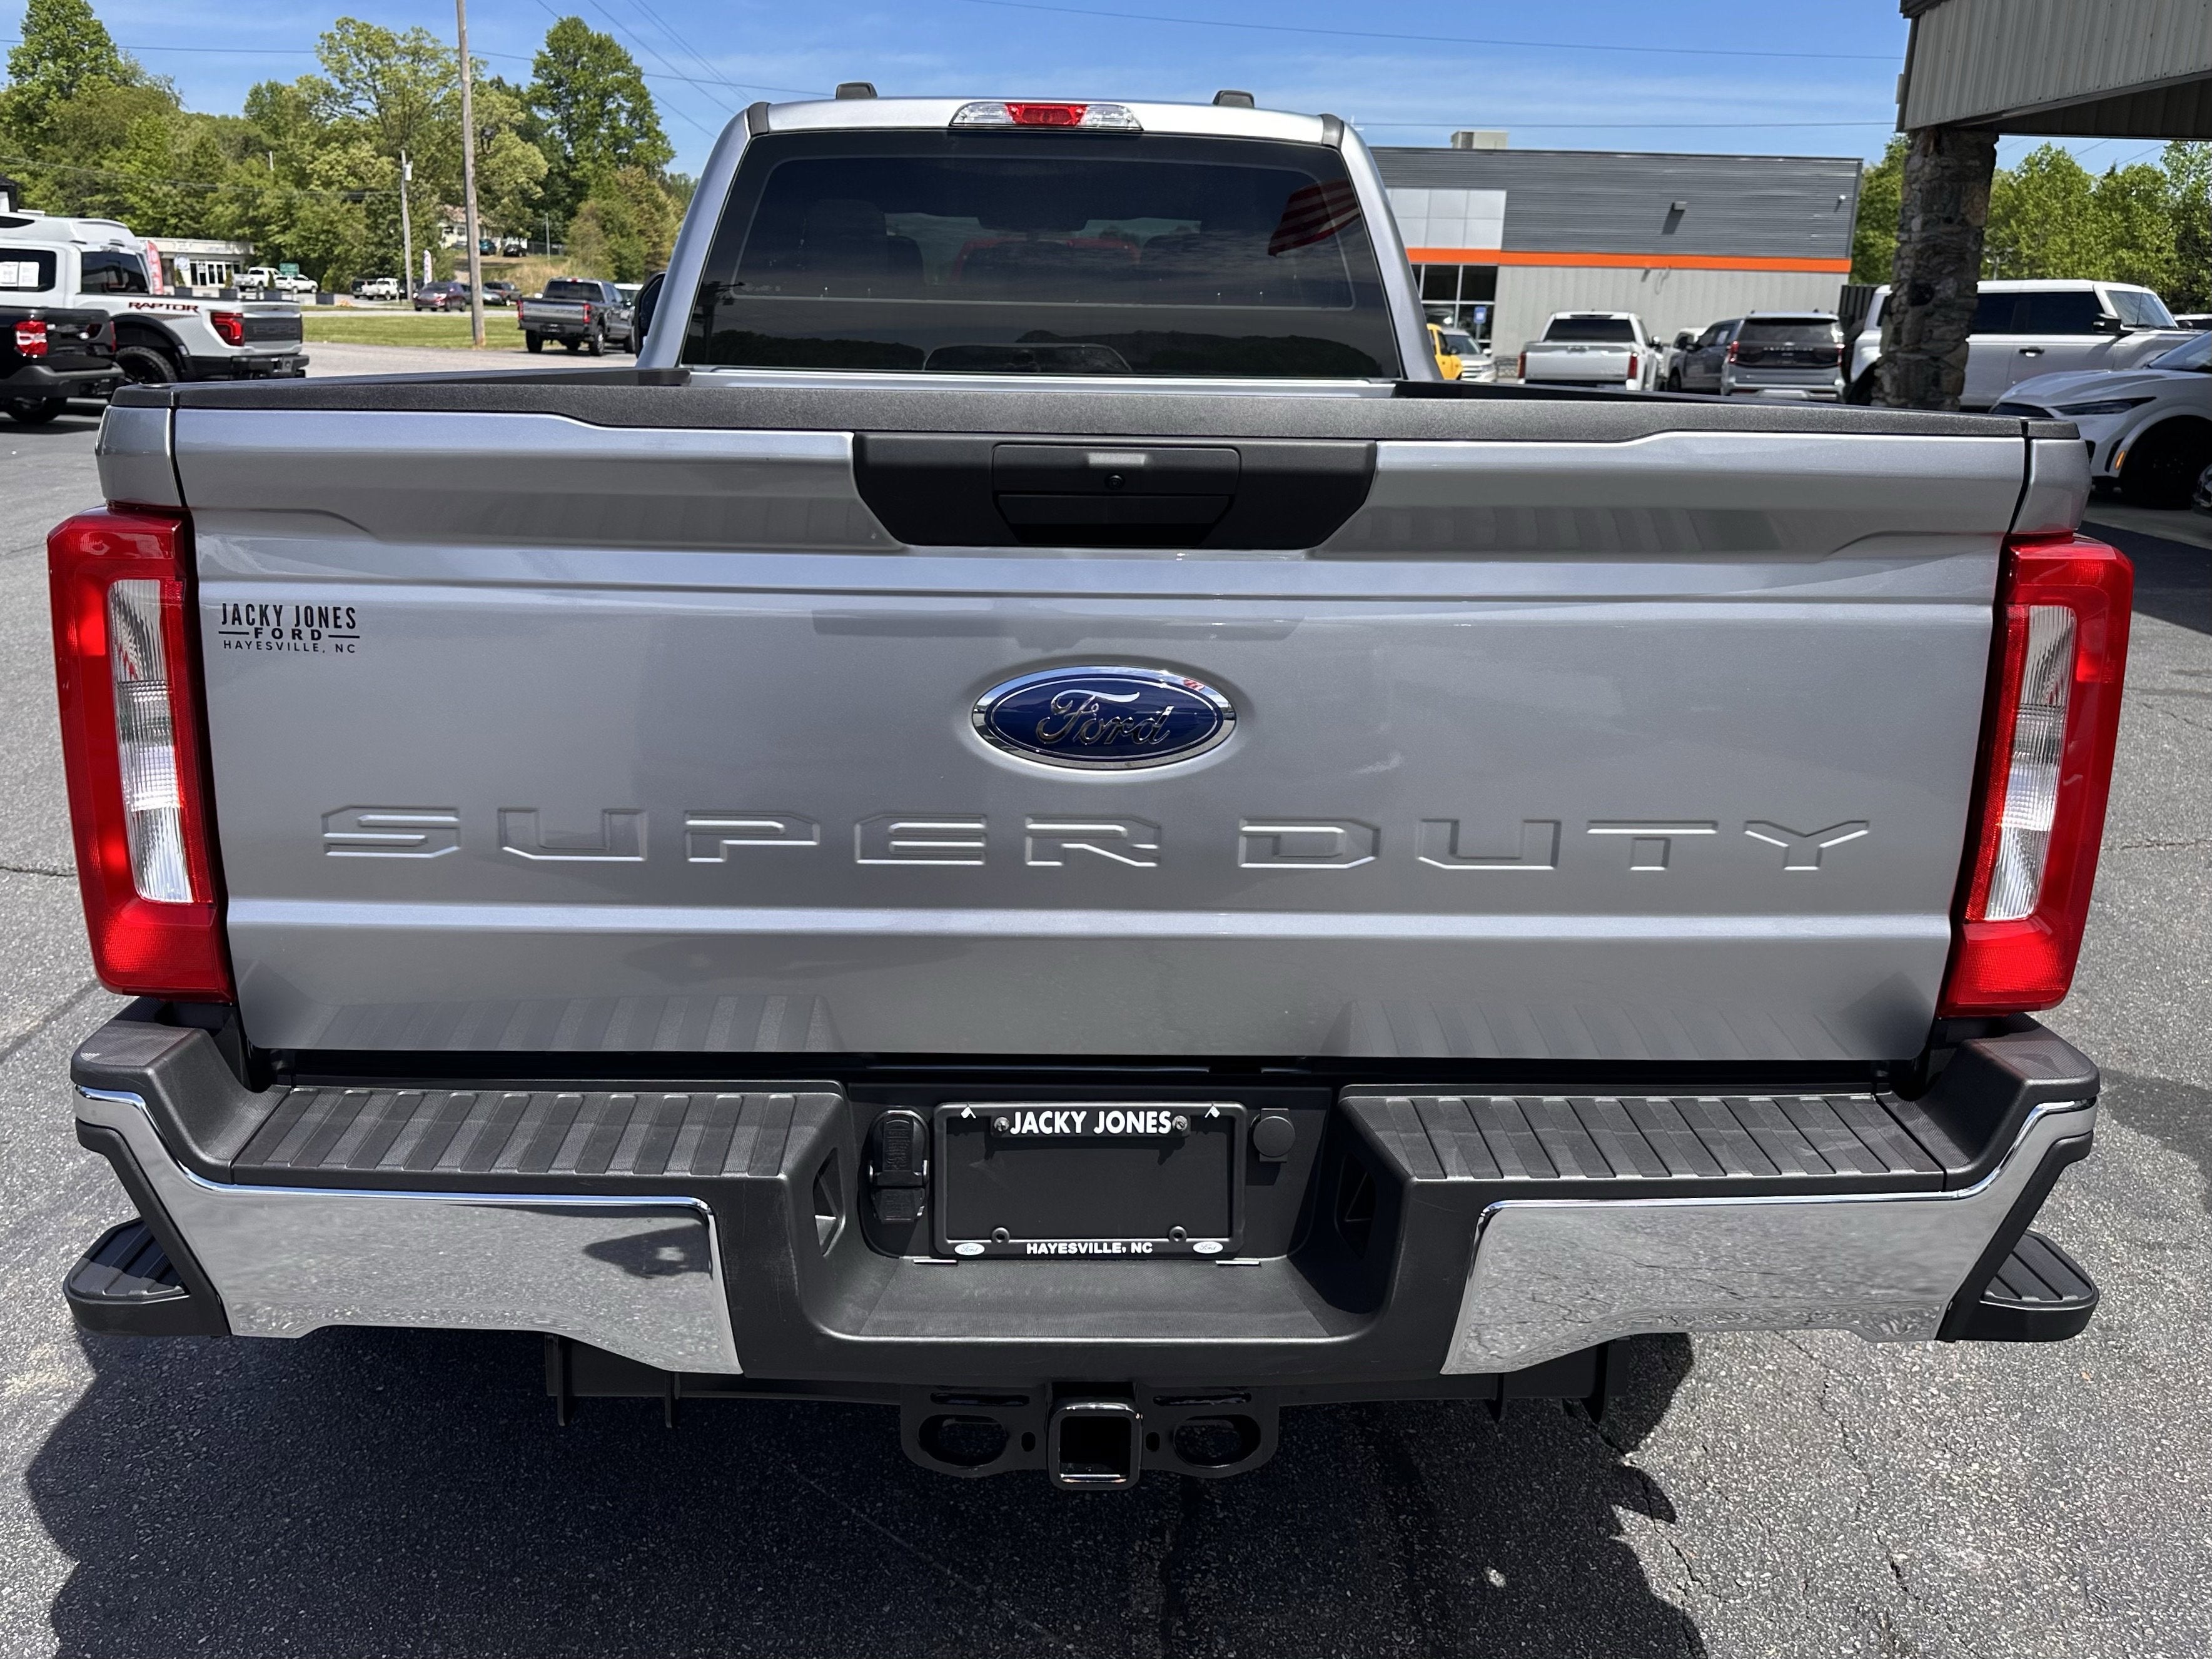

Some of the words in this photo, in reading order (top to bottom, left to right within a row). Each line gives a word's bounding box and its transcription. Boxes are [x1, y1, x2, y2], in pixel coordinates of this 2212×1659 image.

[129, 302, 199, 313] RAPTOR
[221, 603, 283, 627] JACKY
[294, 605, 356, 629] JONES
[254, 627, 322, 640] FORD
[223, 640, 326, 653] HAYESVILLE,
[335, 644, 355, 653] NC
[1036, 688, 1174, 745] Ford
[321, 805, 1161, 867] SUPER
[1238, 817, 1869, 871] DUTY
[1009, 1111, 1087, 1134] JACKY
[1094, 1111, 1171, 1134] JONES
[1026, 1243, 1126, 1254] HAYESVILLE,
[1131, 1242, 1153, 1253] NC
